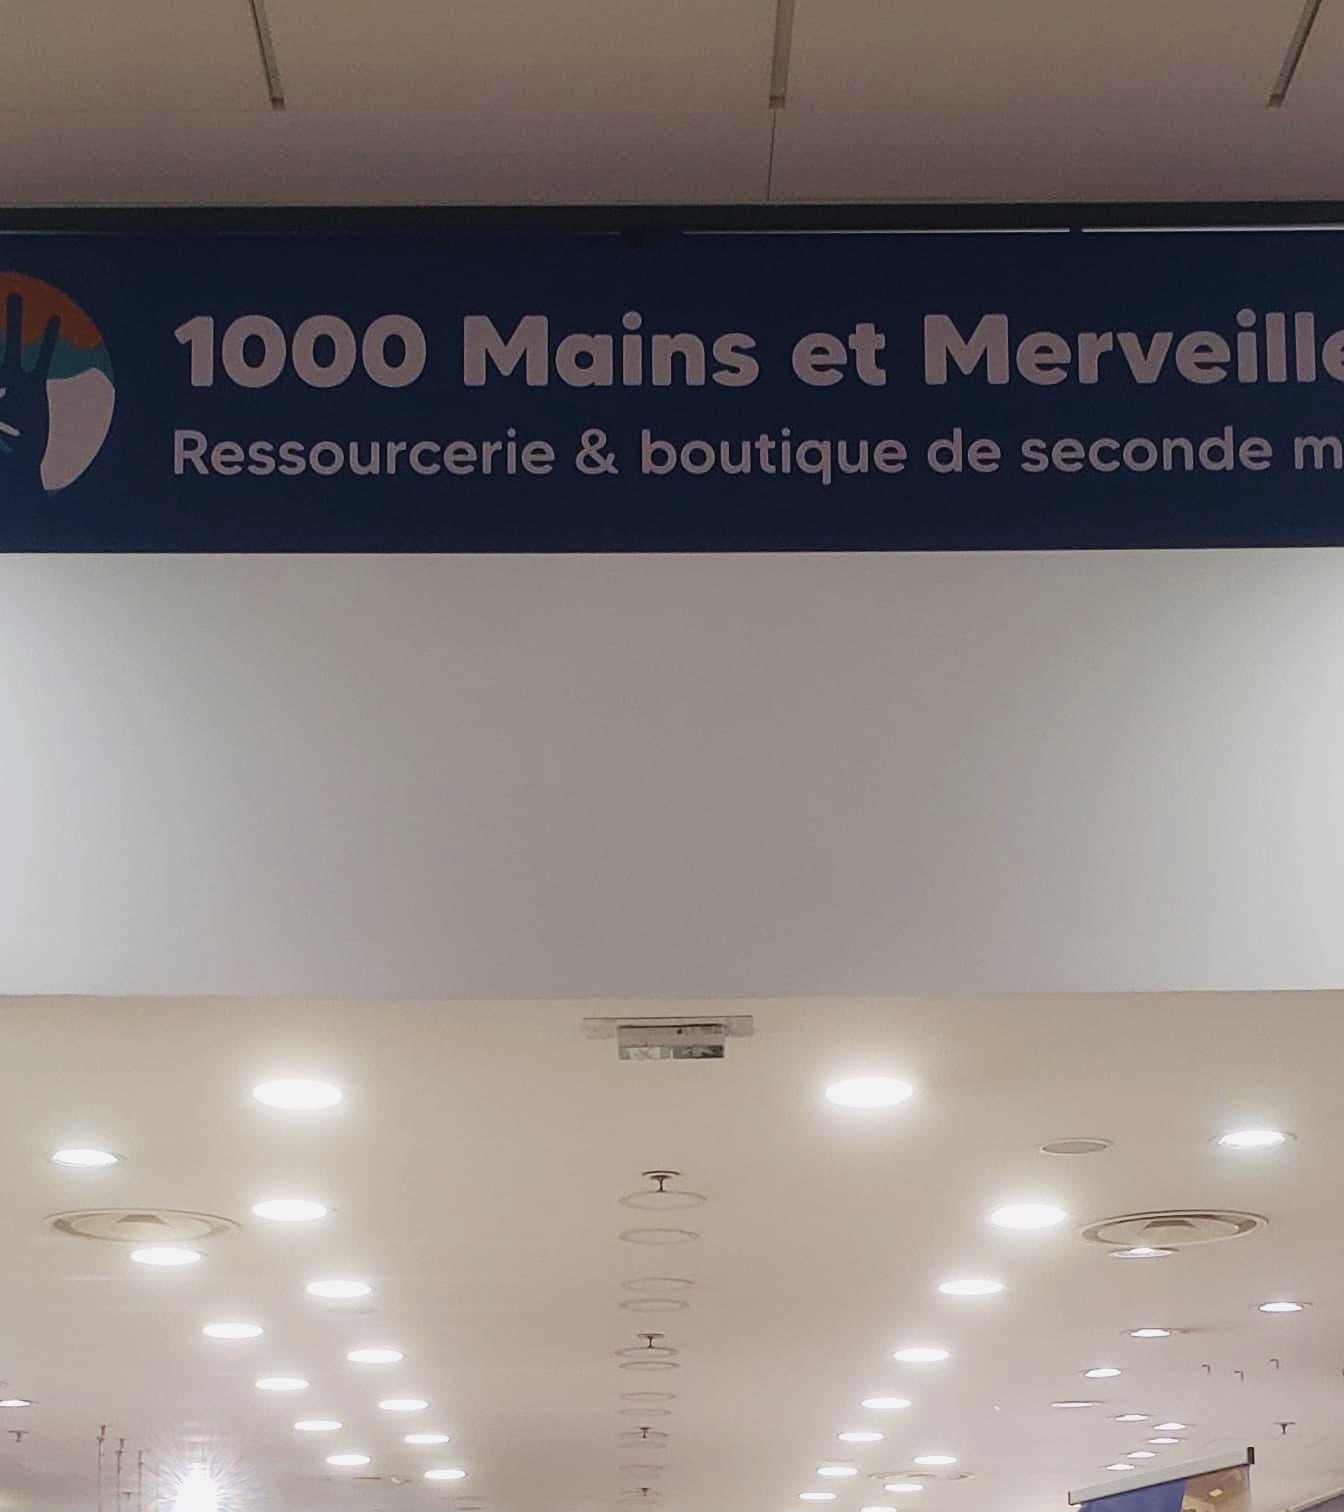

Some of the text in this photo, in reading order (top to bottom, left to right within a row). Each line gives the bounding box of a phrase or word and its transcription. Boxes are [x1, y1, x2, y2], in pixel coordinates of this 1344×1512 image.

[175, 313, 425, 388] 1000
[462, 310, 759, 388] Mains
[792, 316, 885, 388] et
[174, 428, 554, 480] Ressourcerie
[575, 430, 616, 476] &
[643, 425, 907, 486] boutique
[927, 426, 1001, 474] de
[1018, 423, 1272, 473] seconde
